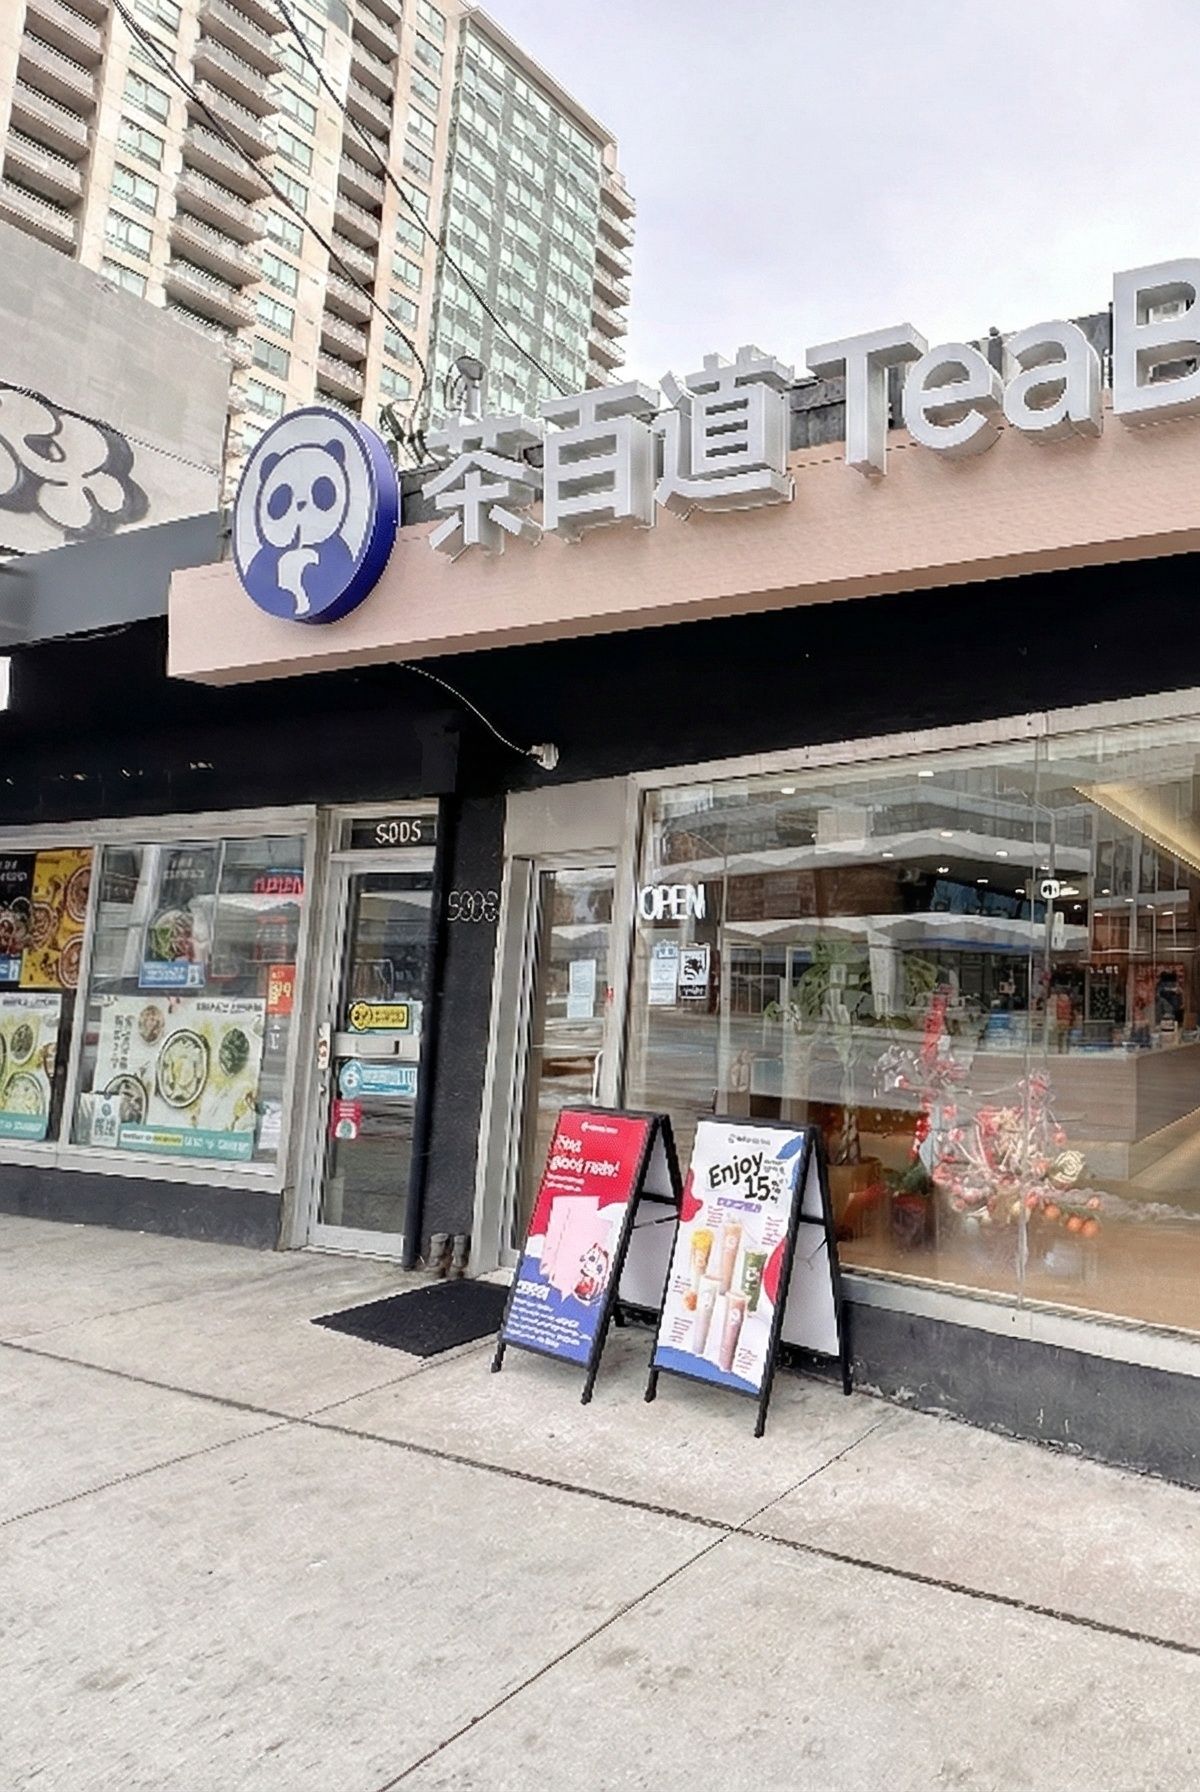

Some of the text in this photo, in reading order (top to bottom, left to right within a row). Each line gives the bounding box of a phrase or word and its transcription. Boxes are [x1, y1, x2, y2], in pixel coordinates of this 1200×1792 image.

[422, 344, 795, 562] 茶百道
[640, 884, 706, 920] OPEN
[708, 1152, 763, 1189] Enjoy
